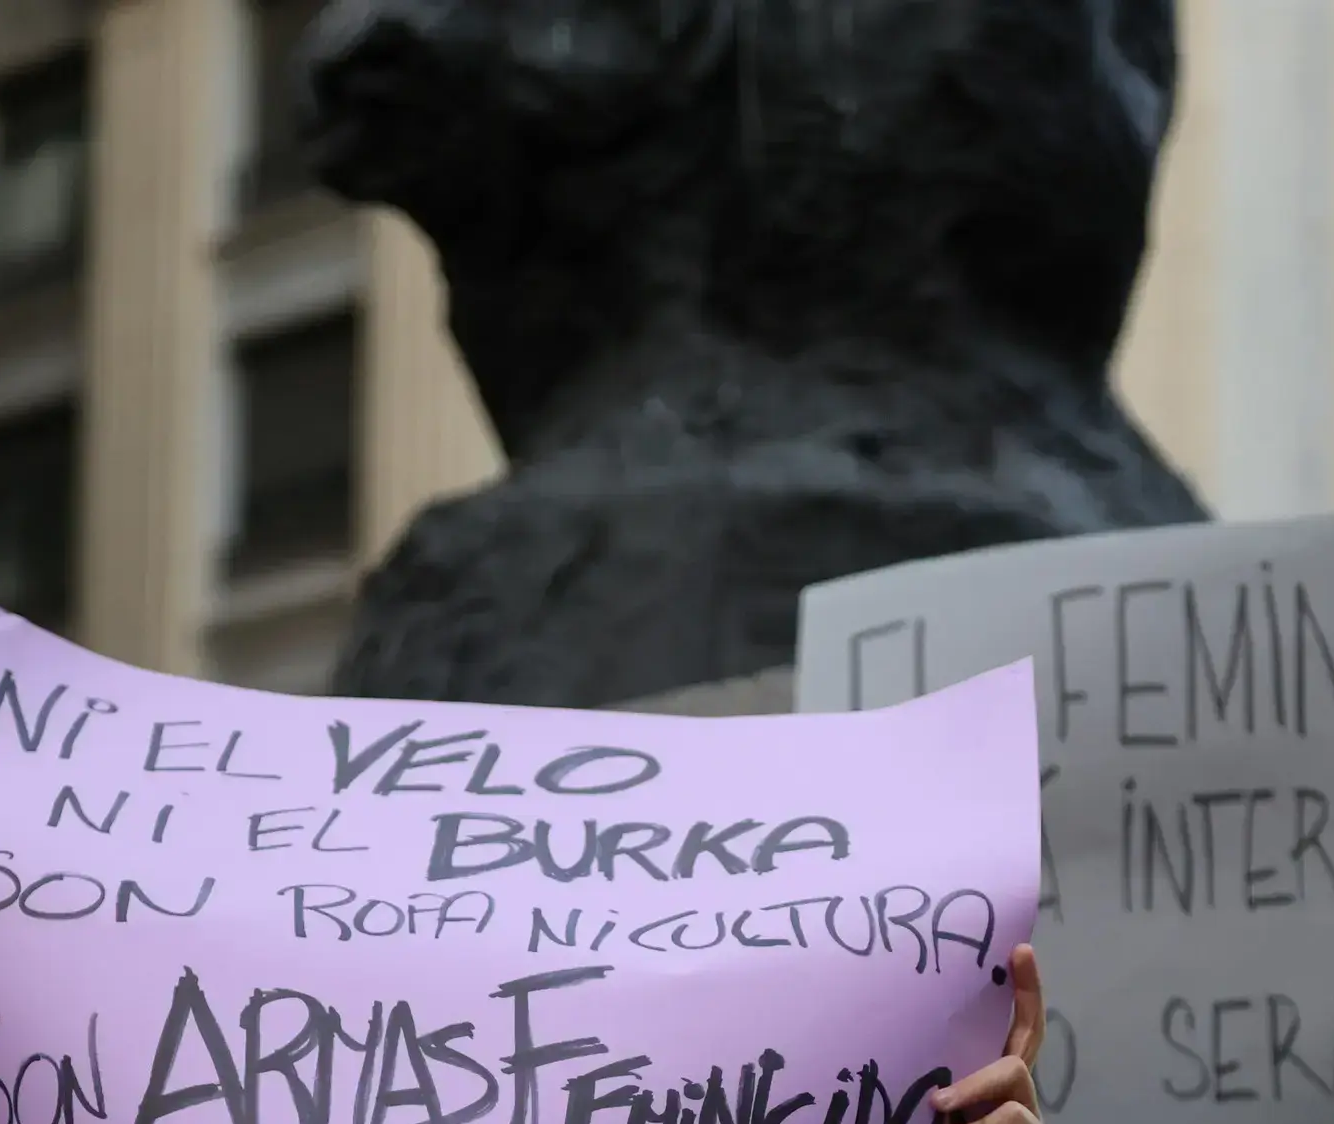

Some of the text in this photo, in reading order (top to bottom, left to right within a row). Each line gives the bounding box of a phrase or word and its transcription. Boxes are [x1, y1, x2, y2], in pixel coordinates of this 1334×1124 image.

[143, 719, 282, 780] EL
[327, 719, 661, 797] VELO
[247, 806, 370, 852] EL
[427, 812, 851, 883] BURKA
